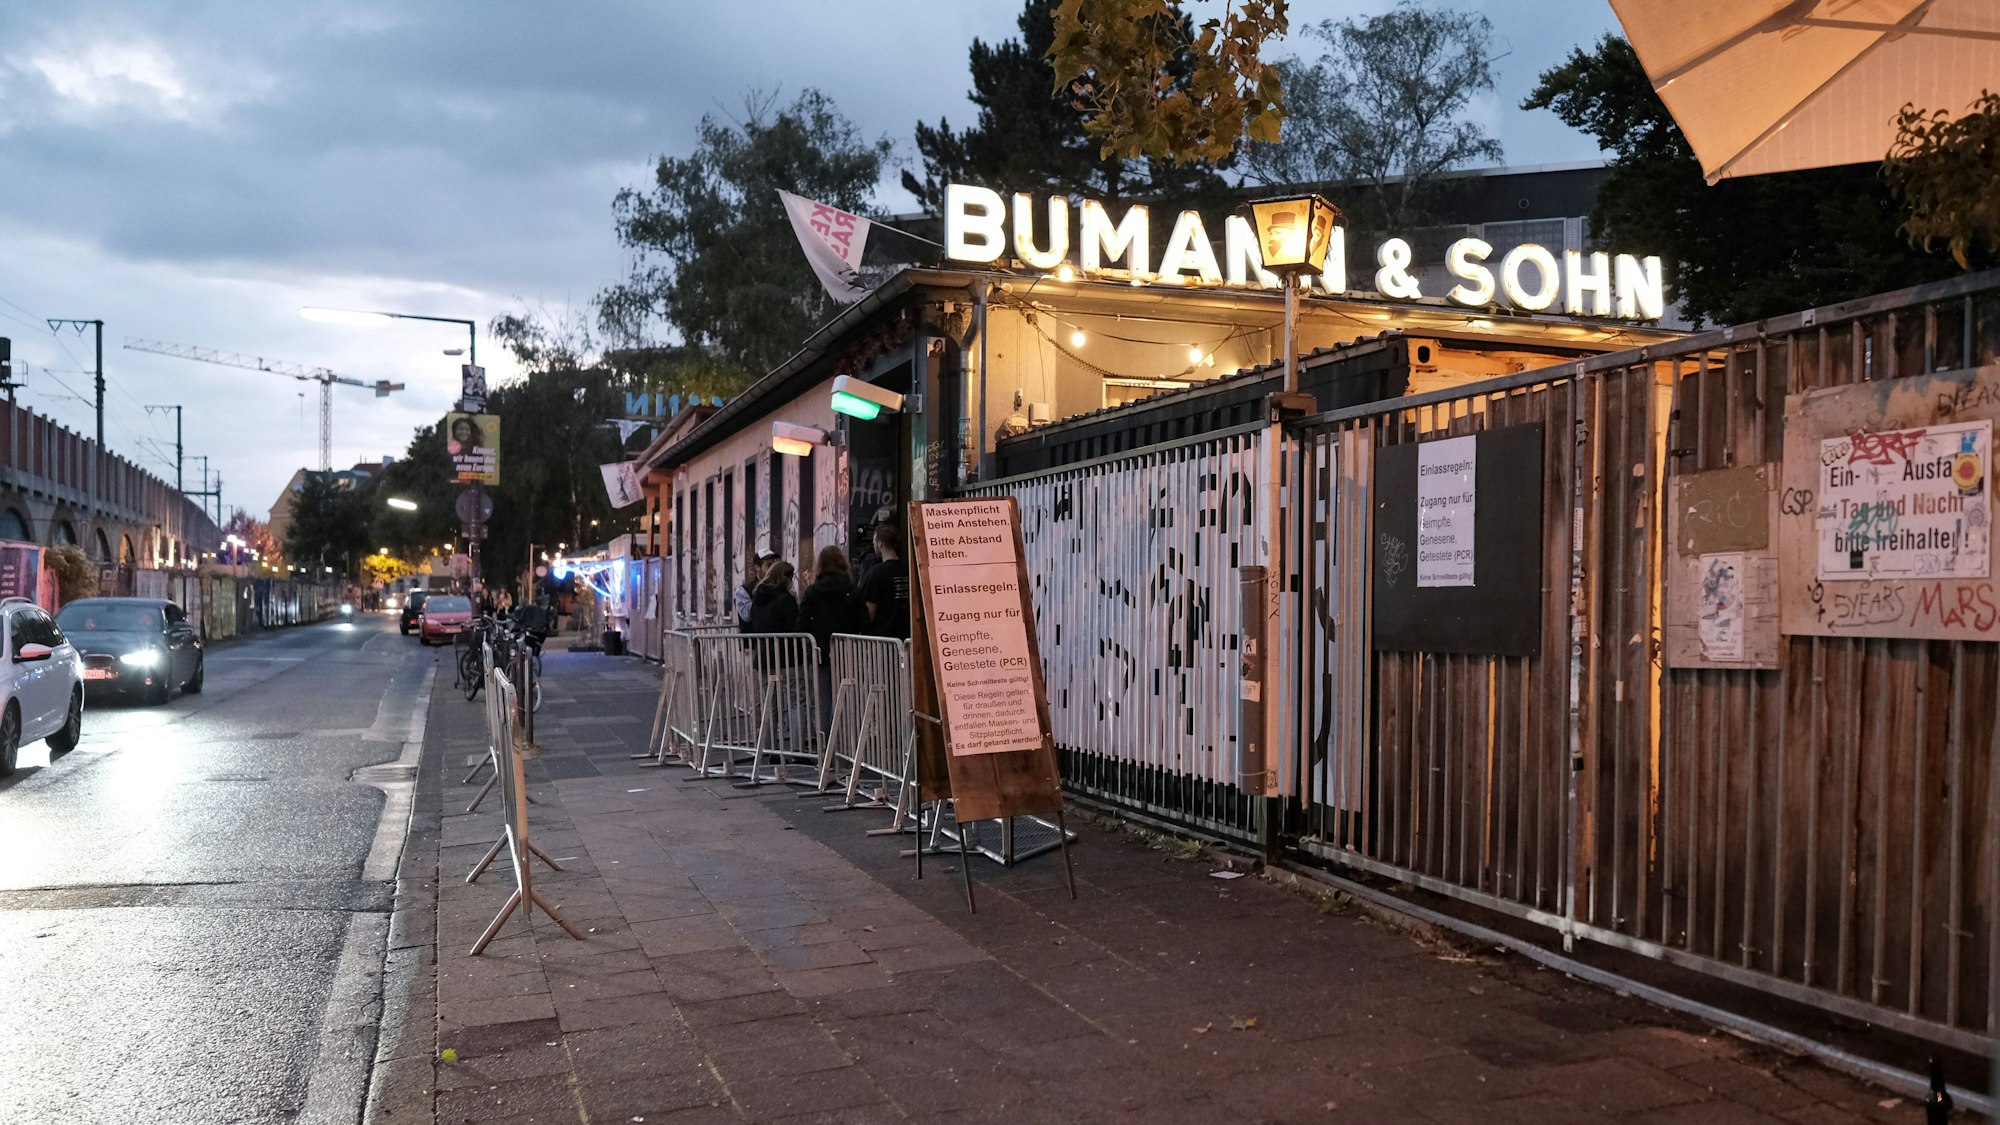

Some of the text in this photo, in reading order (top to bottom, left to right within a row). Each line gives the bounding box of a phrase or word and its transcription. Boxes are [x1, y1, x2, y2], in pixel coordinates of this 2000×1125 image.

[1375, 237, 1423, 299] &
[1446, 238, 1664, 320] SOHN
[1420, 460, 1473, 476] Einlassregeln:
[1830, 467, 1860, 488] Ein-
[1420, 492, 1473, 509] Zugang nur für
[1841, 498, 1869, 522] Tag
[1876, 497, 1905, 517] und
[1914, 492, 1964, 515] Nacht
[926, 505, 1000, 517] Maskenpflicht
[927, 518, 1010, 530] beim Anstehen.
[1420, 516, 1453, 531] Geimpfte,
[930, 534, 1002, 546] Bitte Abstand
[1420, 533, 1457, 546] Genesene,
[1835, 532, 1870, 553] bitte
[931, 550, 968, 559] halten.
[1420, 549, 1473, 562] Getestete (PCR)
[934, 582, 1017, 595] Einlassregeln:
[1910, 582, 1997, 632] MARS
[938, 608, 1020, 622] Zugang nur für
[940, 631, 993, 643] Geimpfte,
[942, 645, 1002, 657] Genesene,
[944, 657, 1028, 671] Getestete (PCR)
[967, 678, 1007, 687] Schnelltests
[1009, 675, 1029, 684] gültig!
[954, 688, 1029, 701] Diese Regeln gelten
[963, 702, 974, 710] für
[975, 700, 1006, 710] draußen
[963, 708, 1025, 720] drinnen, dadurch
[954, 717, 1036, 731] entfallen Masken- und
[969, 727, 1024, 740] Sitzplatzpflicht.
[955, 735, 1040, 750] Es darf getanzt werden!
